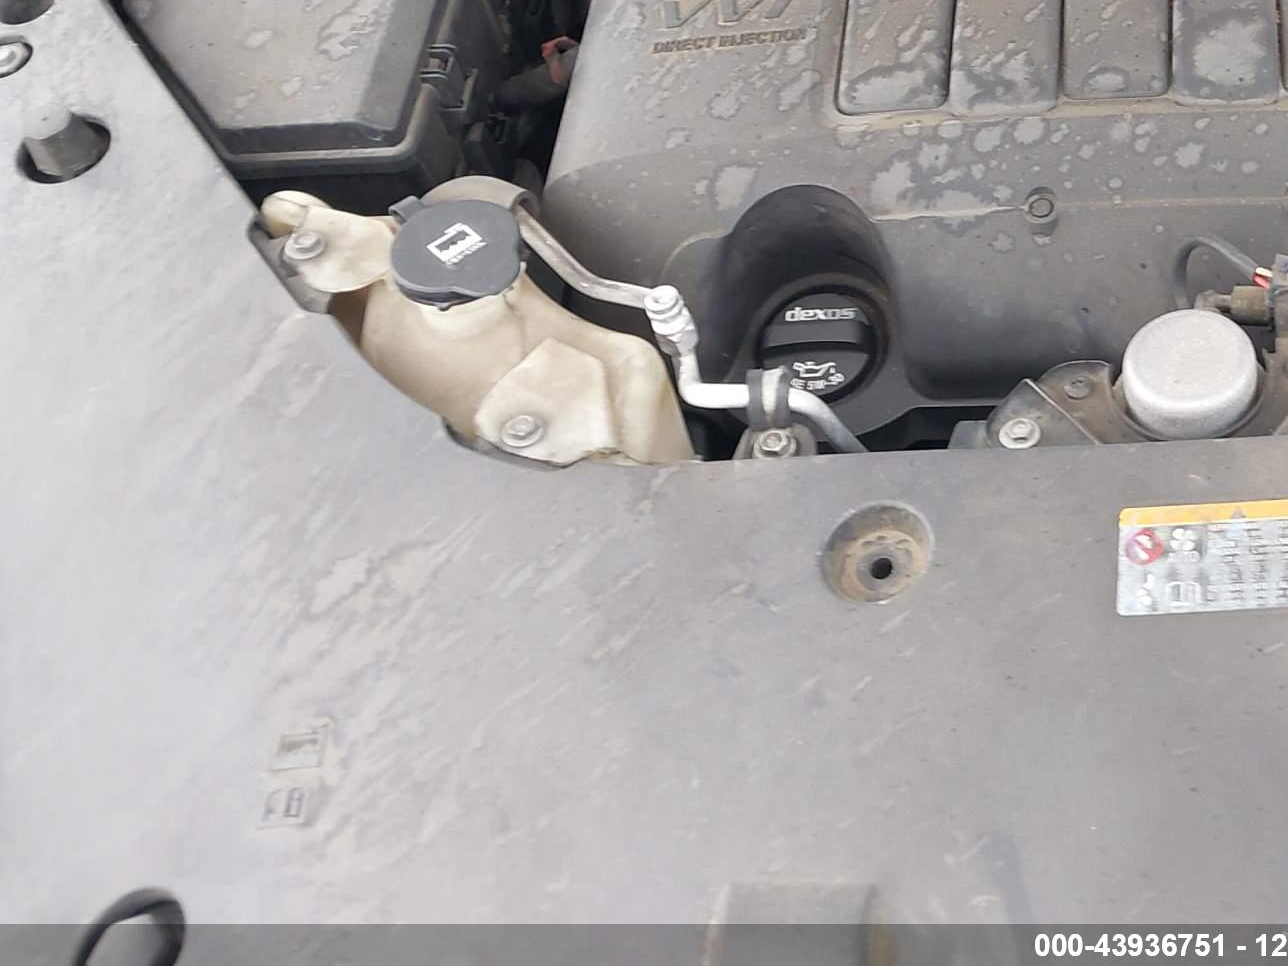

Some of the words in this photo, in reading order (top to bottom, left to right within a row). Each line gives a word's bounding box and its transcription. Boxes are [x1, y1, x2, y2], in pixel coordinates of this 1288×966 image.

[653, 36, 717, 54] DIRECT
[718, 29, 807, 47] INJECTION
[785, 306, 859, 322] dexos
